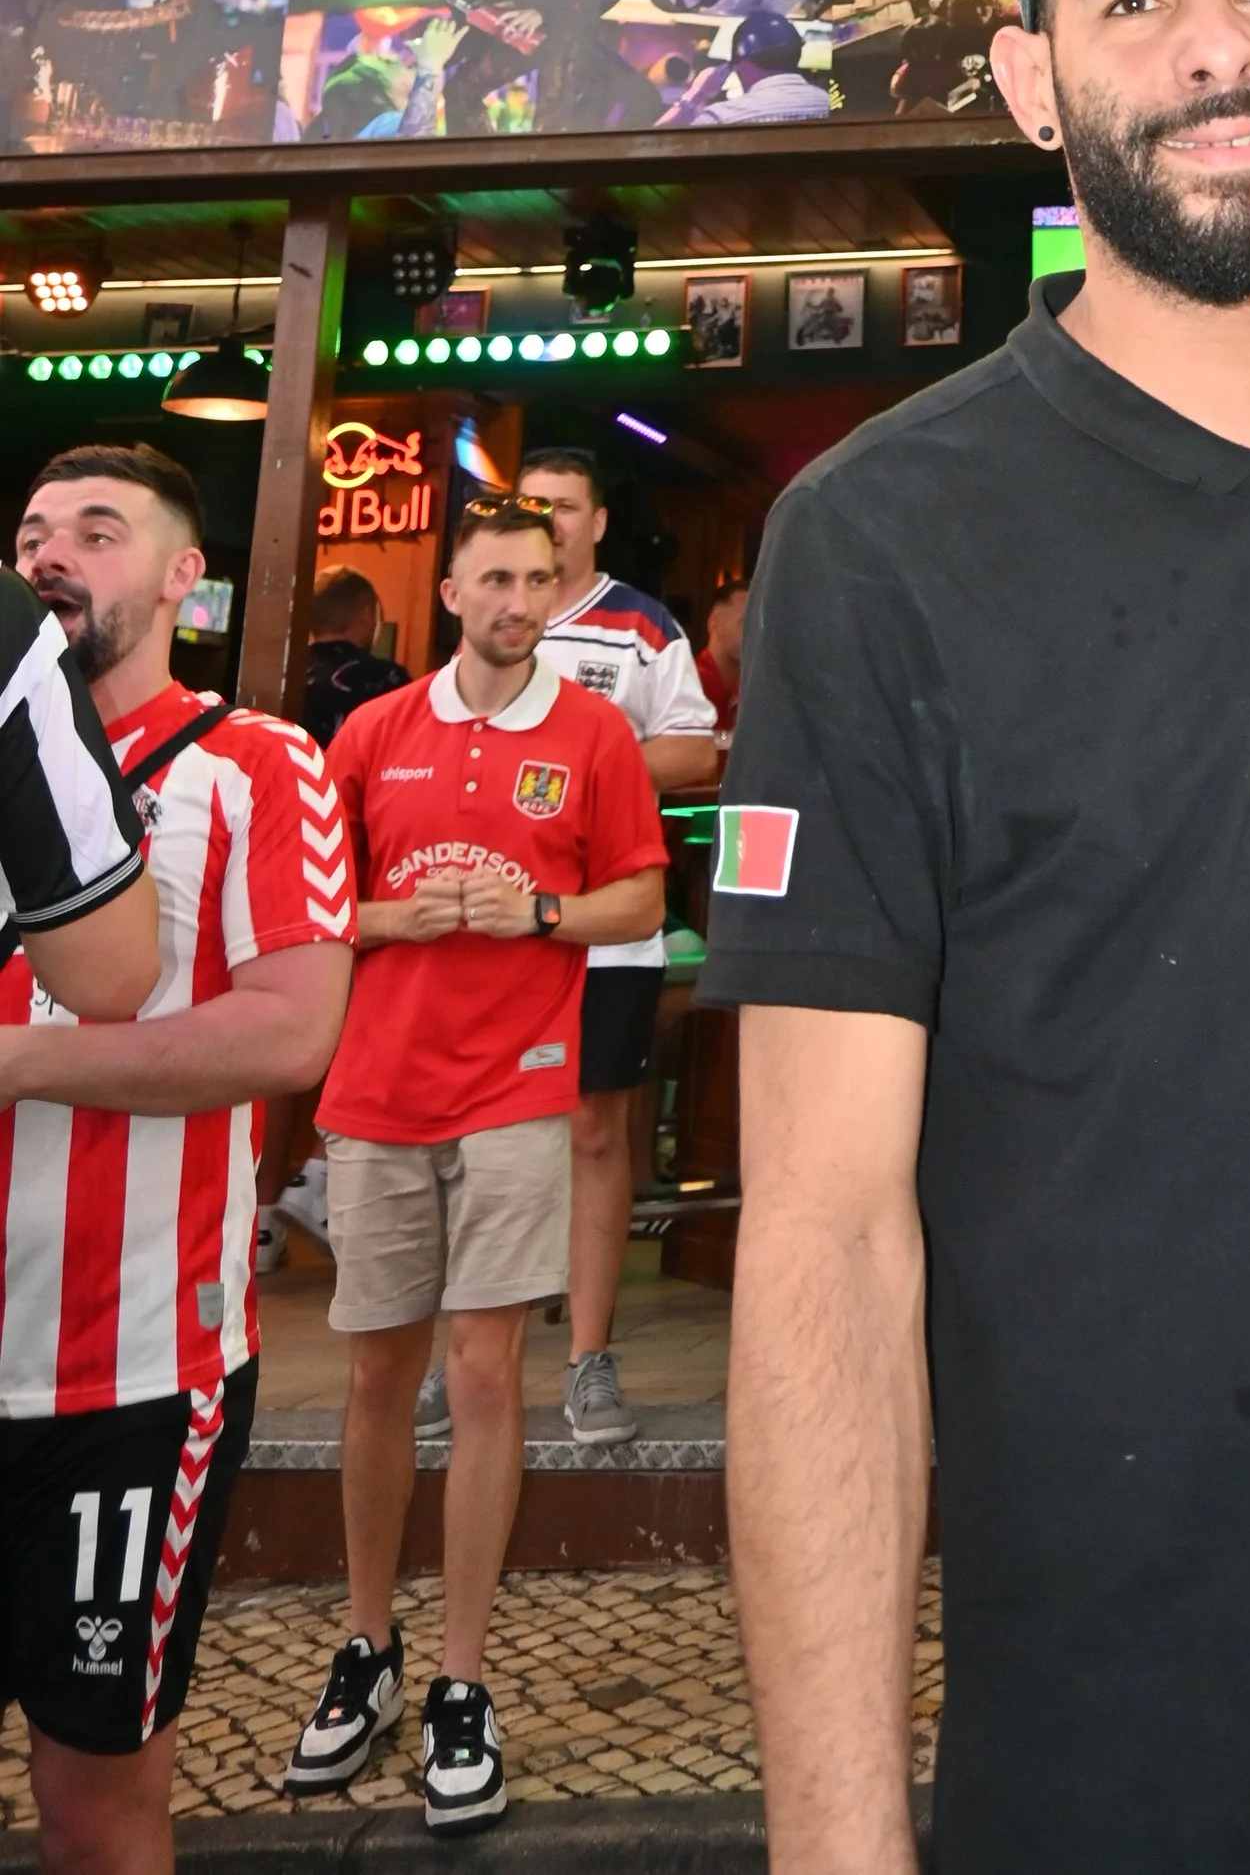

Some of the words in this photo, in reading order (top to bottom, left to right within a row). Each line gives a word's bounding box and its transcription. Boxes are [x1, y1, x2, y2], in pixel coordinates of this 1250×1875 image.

[350, 484, 431, 534] Bull
[380, 765, 435, 783] uhlsport
[386, 840, 538, 897] SANDERSON
[70, 1486, 153, 1603] 11
[72, 1653, 123, 1676] hummel
